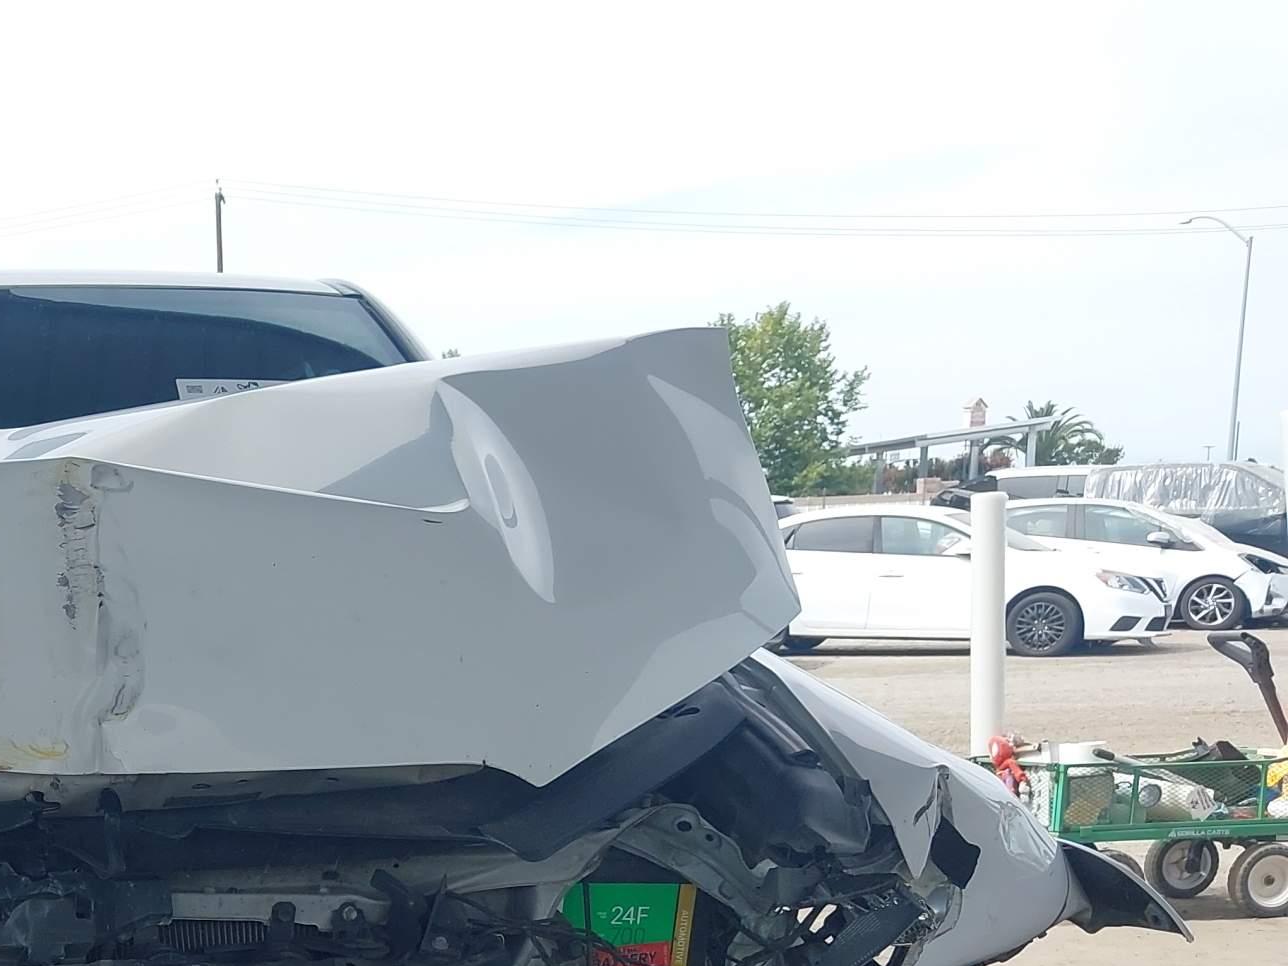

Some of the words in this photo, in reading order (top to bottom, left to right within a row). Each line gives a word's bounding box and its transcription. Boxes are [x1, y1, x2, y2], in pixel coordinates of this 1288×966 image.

[610, 905, 650, 925] 24F
[613, 927, 646, 946] 700
[675, 910, 689, 964] AUTOMOTIVE
